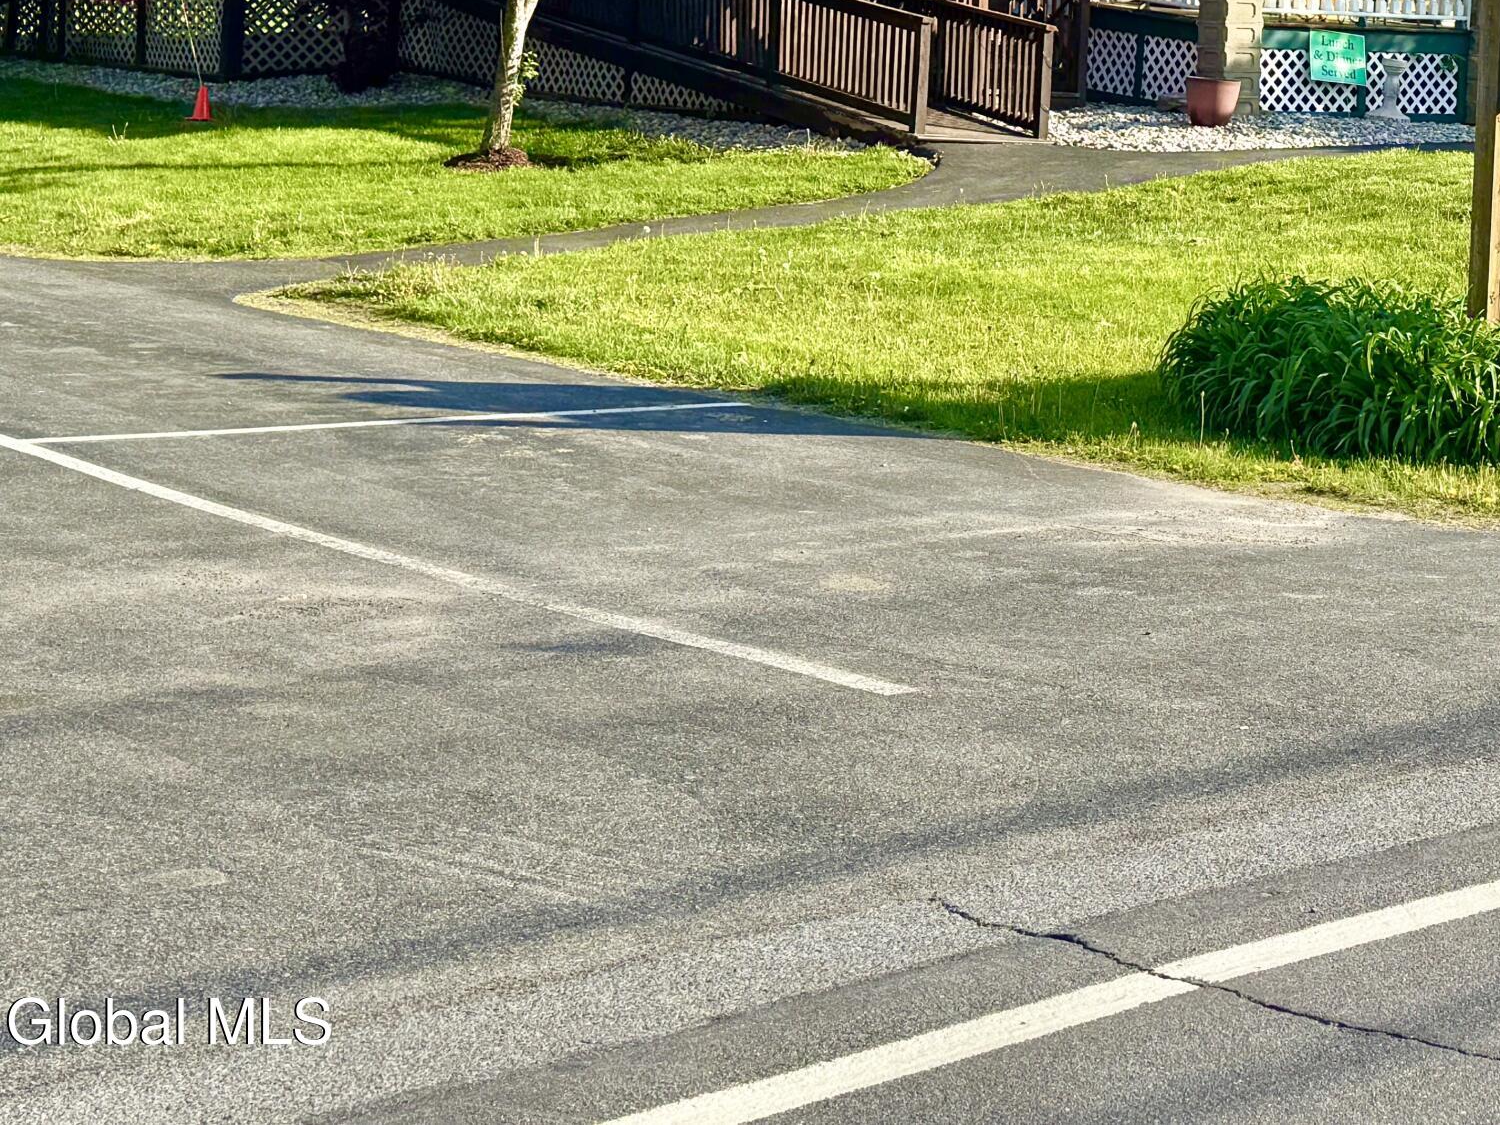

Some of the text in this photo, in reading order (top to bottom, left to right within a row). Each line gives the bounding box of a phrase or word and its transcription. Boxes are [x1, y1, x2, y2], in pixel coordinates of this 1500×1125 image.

[1321, 35, 1354, 50] Luch
[1313, 49, 1323, 61] &
[1321, 65, 1356, 79] Sered
